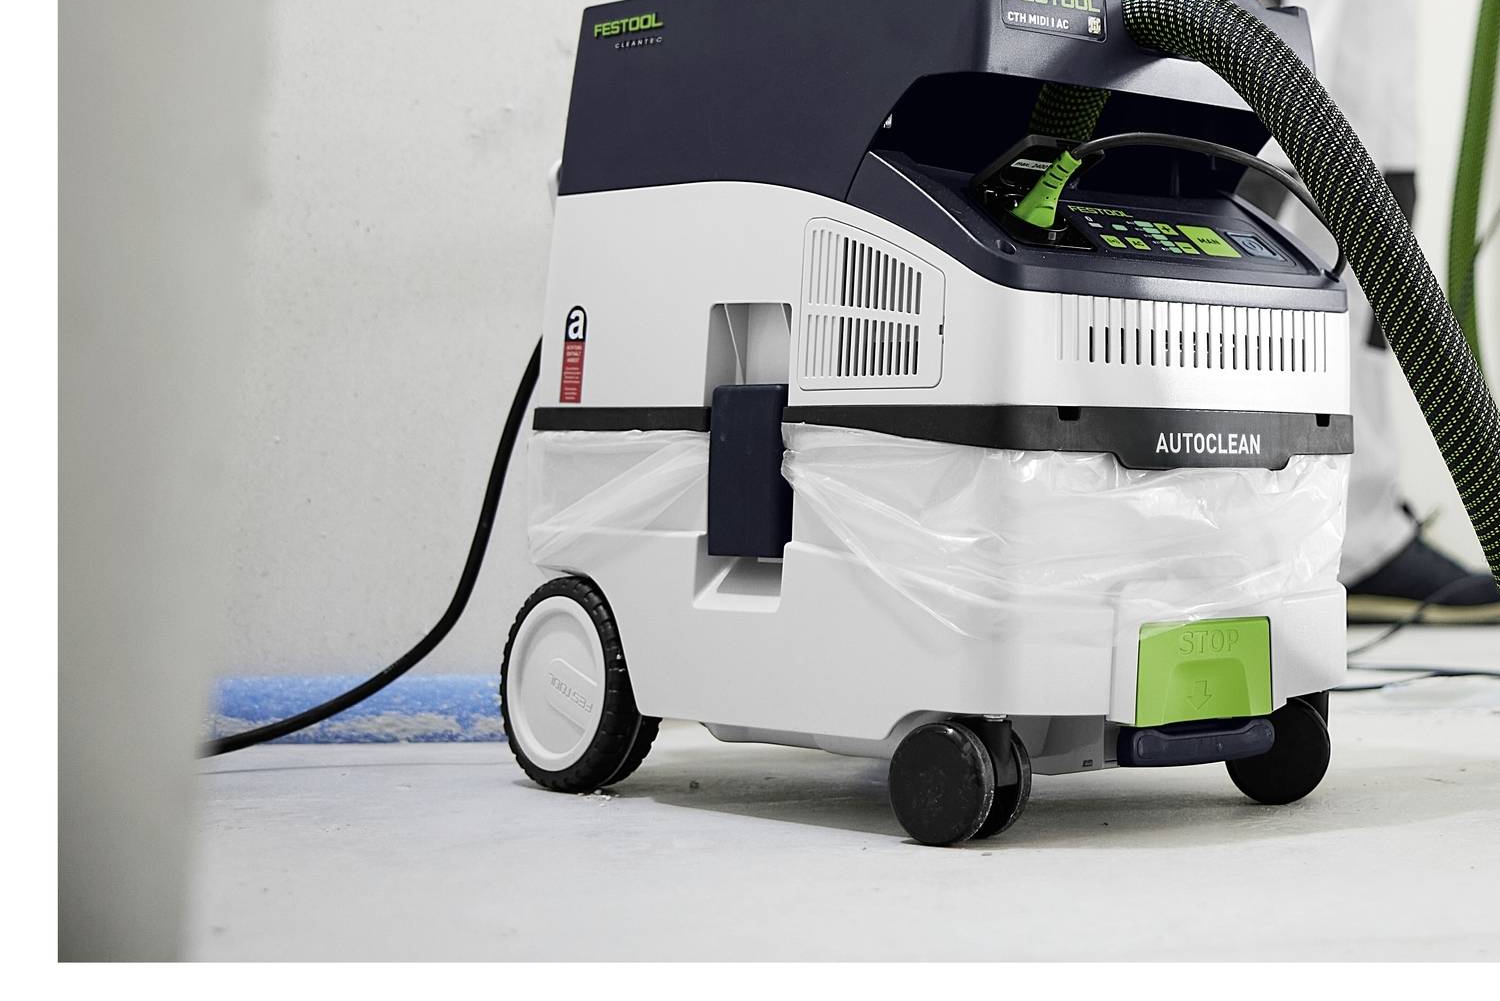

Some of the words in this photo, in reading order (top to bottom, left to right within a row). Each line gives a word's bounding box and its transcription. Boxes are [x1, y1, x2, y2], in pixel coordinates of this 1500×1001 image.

[594, 13, 664, 37] FESTOOL
[1008, 11, 1027, 22] CTH
[1028, 14, 1050, 26] MIDI
[1056, 19, 1069, 29] AC
[615, 37, 663, 49] CLEANTEC
[1067, 204, 1134, 218] FESTOOL
[568, 309, 585, 340] a
[1156, 432, 1261, 455] AUTOCLEAN
[1180, 629, 1239, 655] STOP
